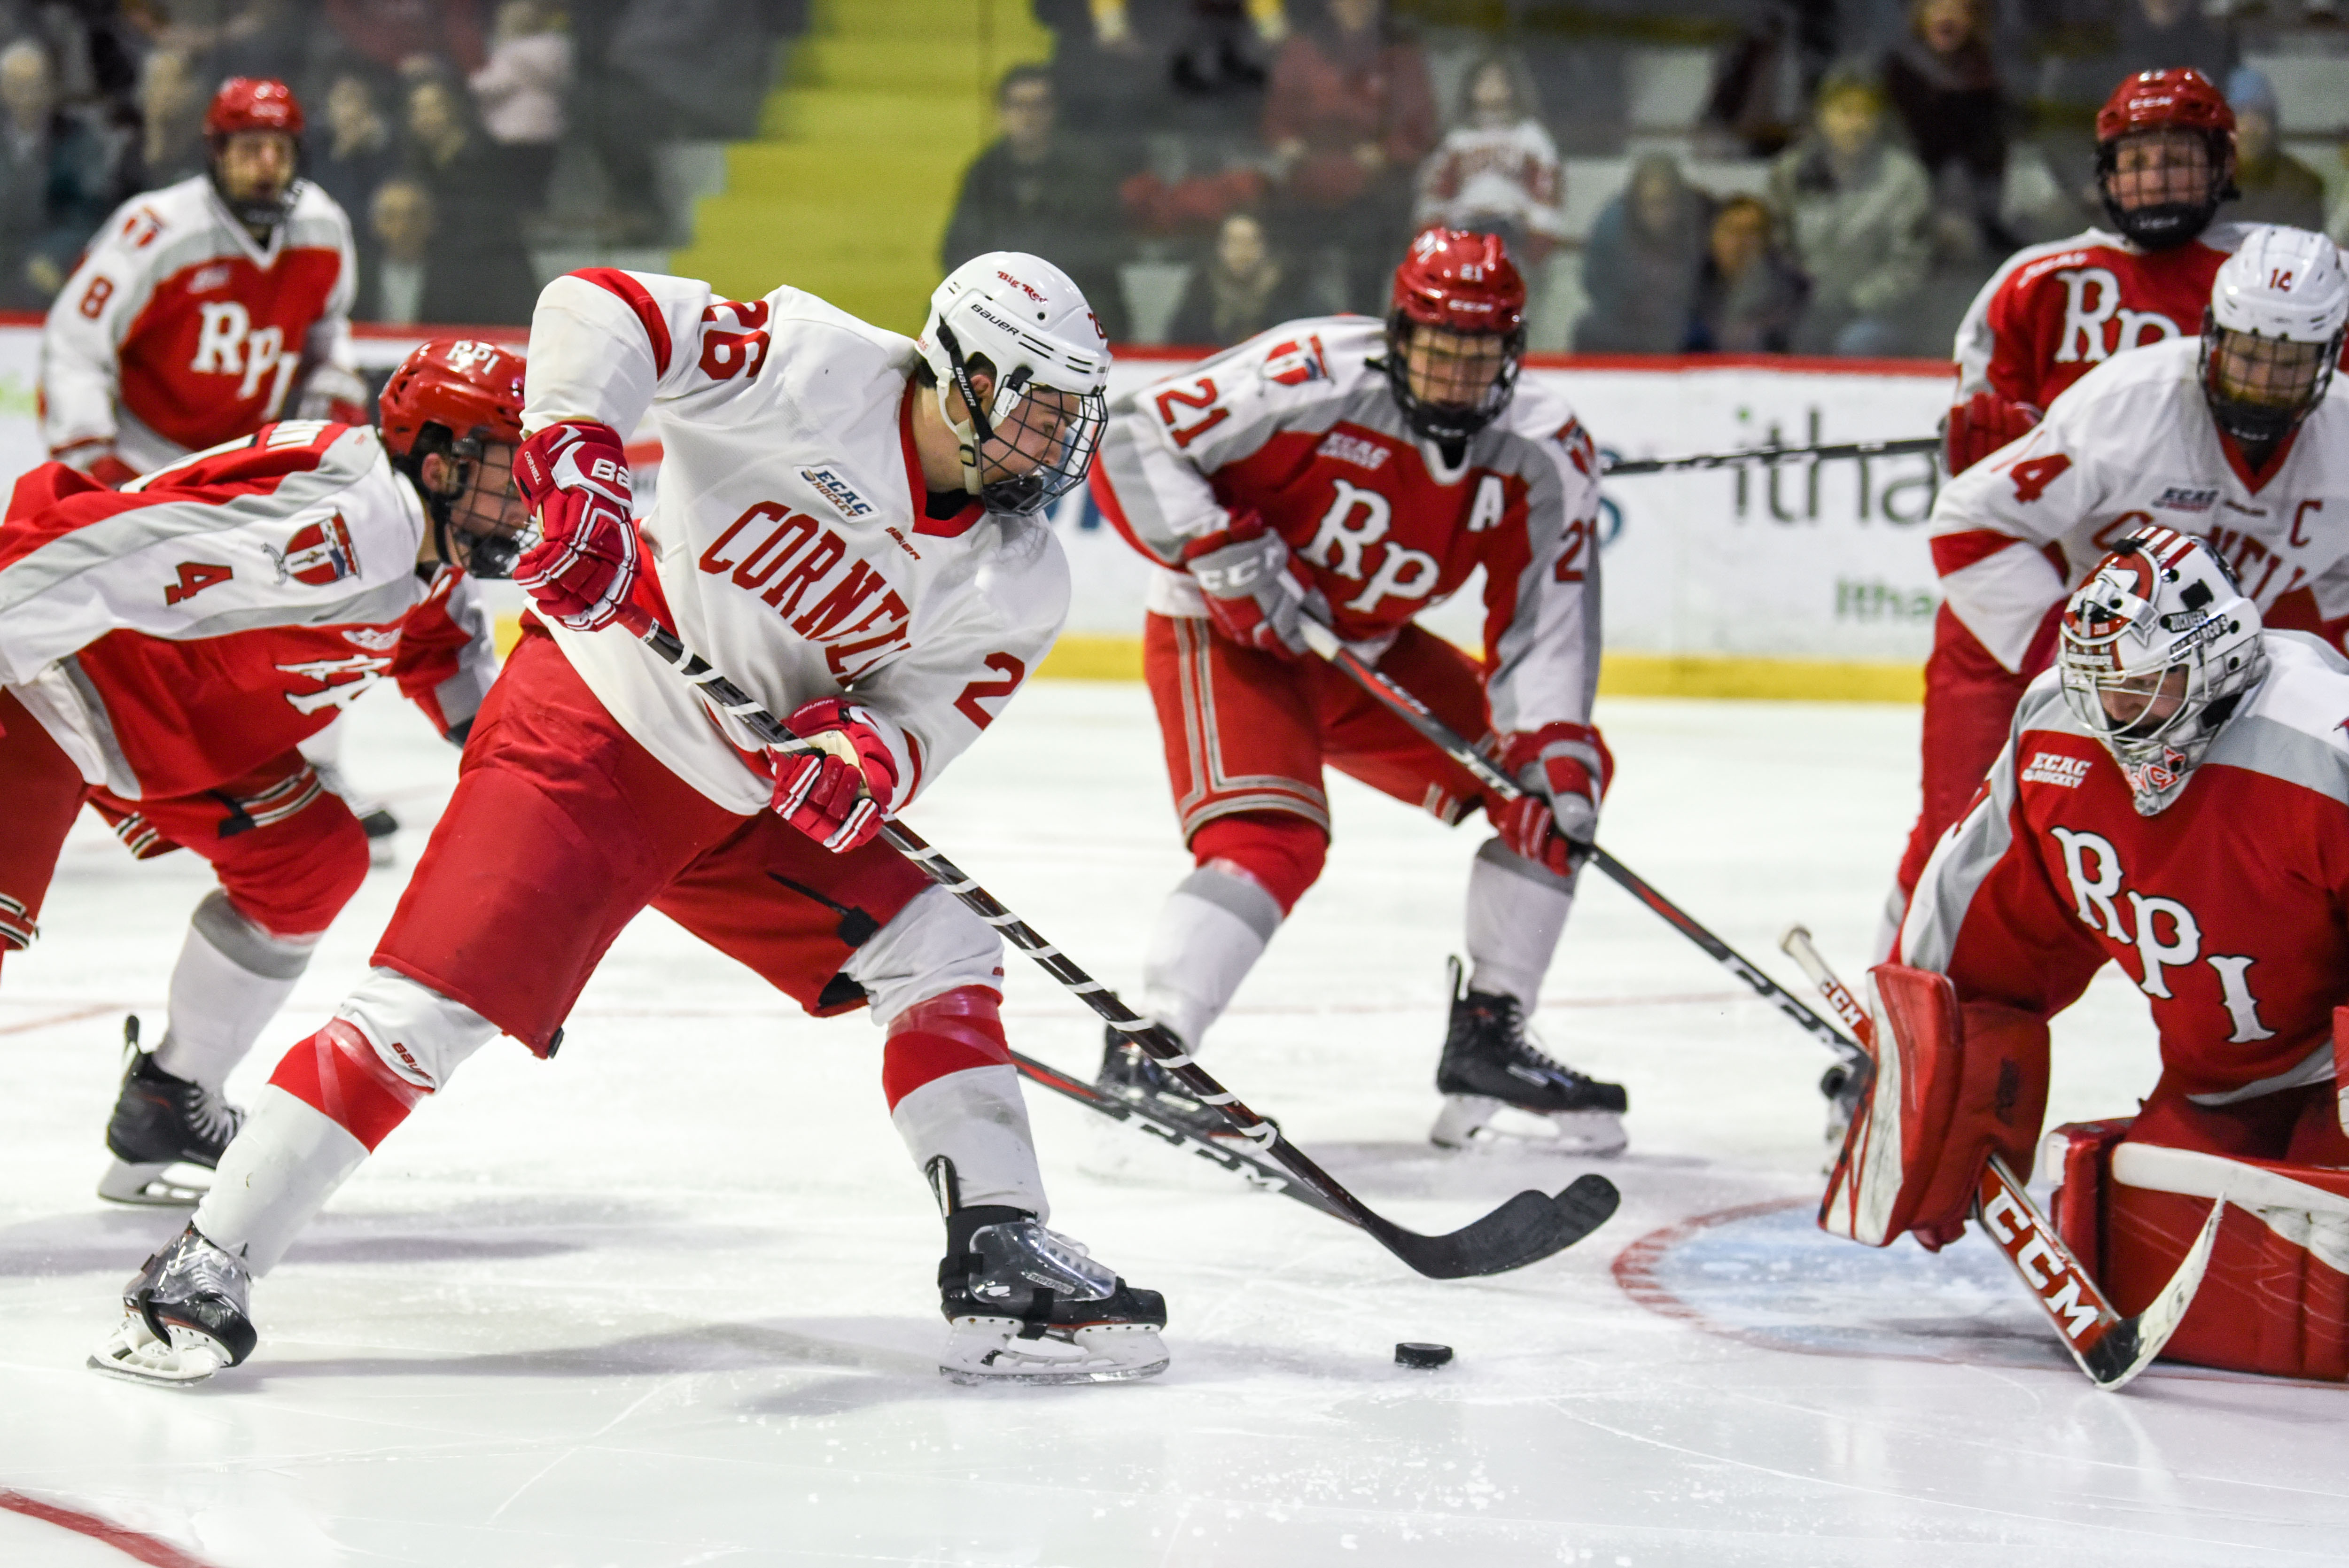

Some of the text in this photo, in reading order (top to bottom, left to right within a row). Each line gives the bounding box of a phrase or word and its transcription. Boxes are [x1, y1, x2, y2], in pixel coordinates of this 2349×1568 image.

[80, 276, 114, 321] 8
[997, 270, 1049, 305] Big Red
[970, 303, 1020, 336] BAUER
[191, 301, 300, 421] RPI
[445, 340, 500, 376] RPI
[955, 367, 977, 407] BAUER
[1155, 377, 1230, 449] 21
[524, 450, 542, 486] CORNELL
[812, 482, 858, 517] HOCKEY
[814, 470, 873, 515] ECAC
[1468, 474, 1504, 532] A
[884, 527, 921, 561] BAUER
[1298, 478, 1440, 613] RP
[2289, 499, 2322, 547] C
[163, 560, 233, 607] 4
[793, 698, 835, 719] BAUER
[953, 652, 1026, 731] 2
[2030, 752, 2093, 777] ECAC
[2033, 769, 2085, 789] HOCKEY
[2050, 825, 2277, 1044] RPI
[1819, 980, 1863, 1029] CCM
[1983, 1184, 2104, 1340] CCM
